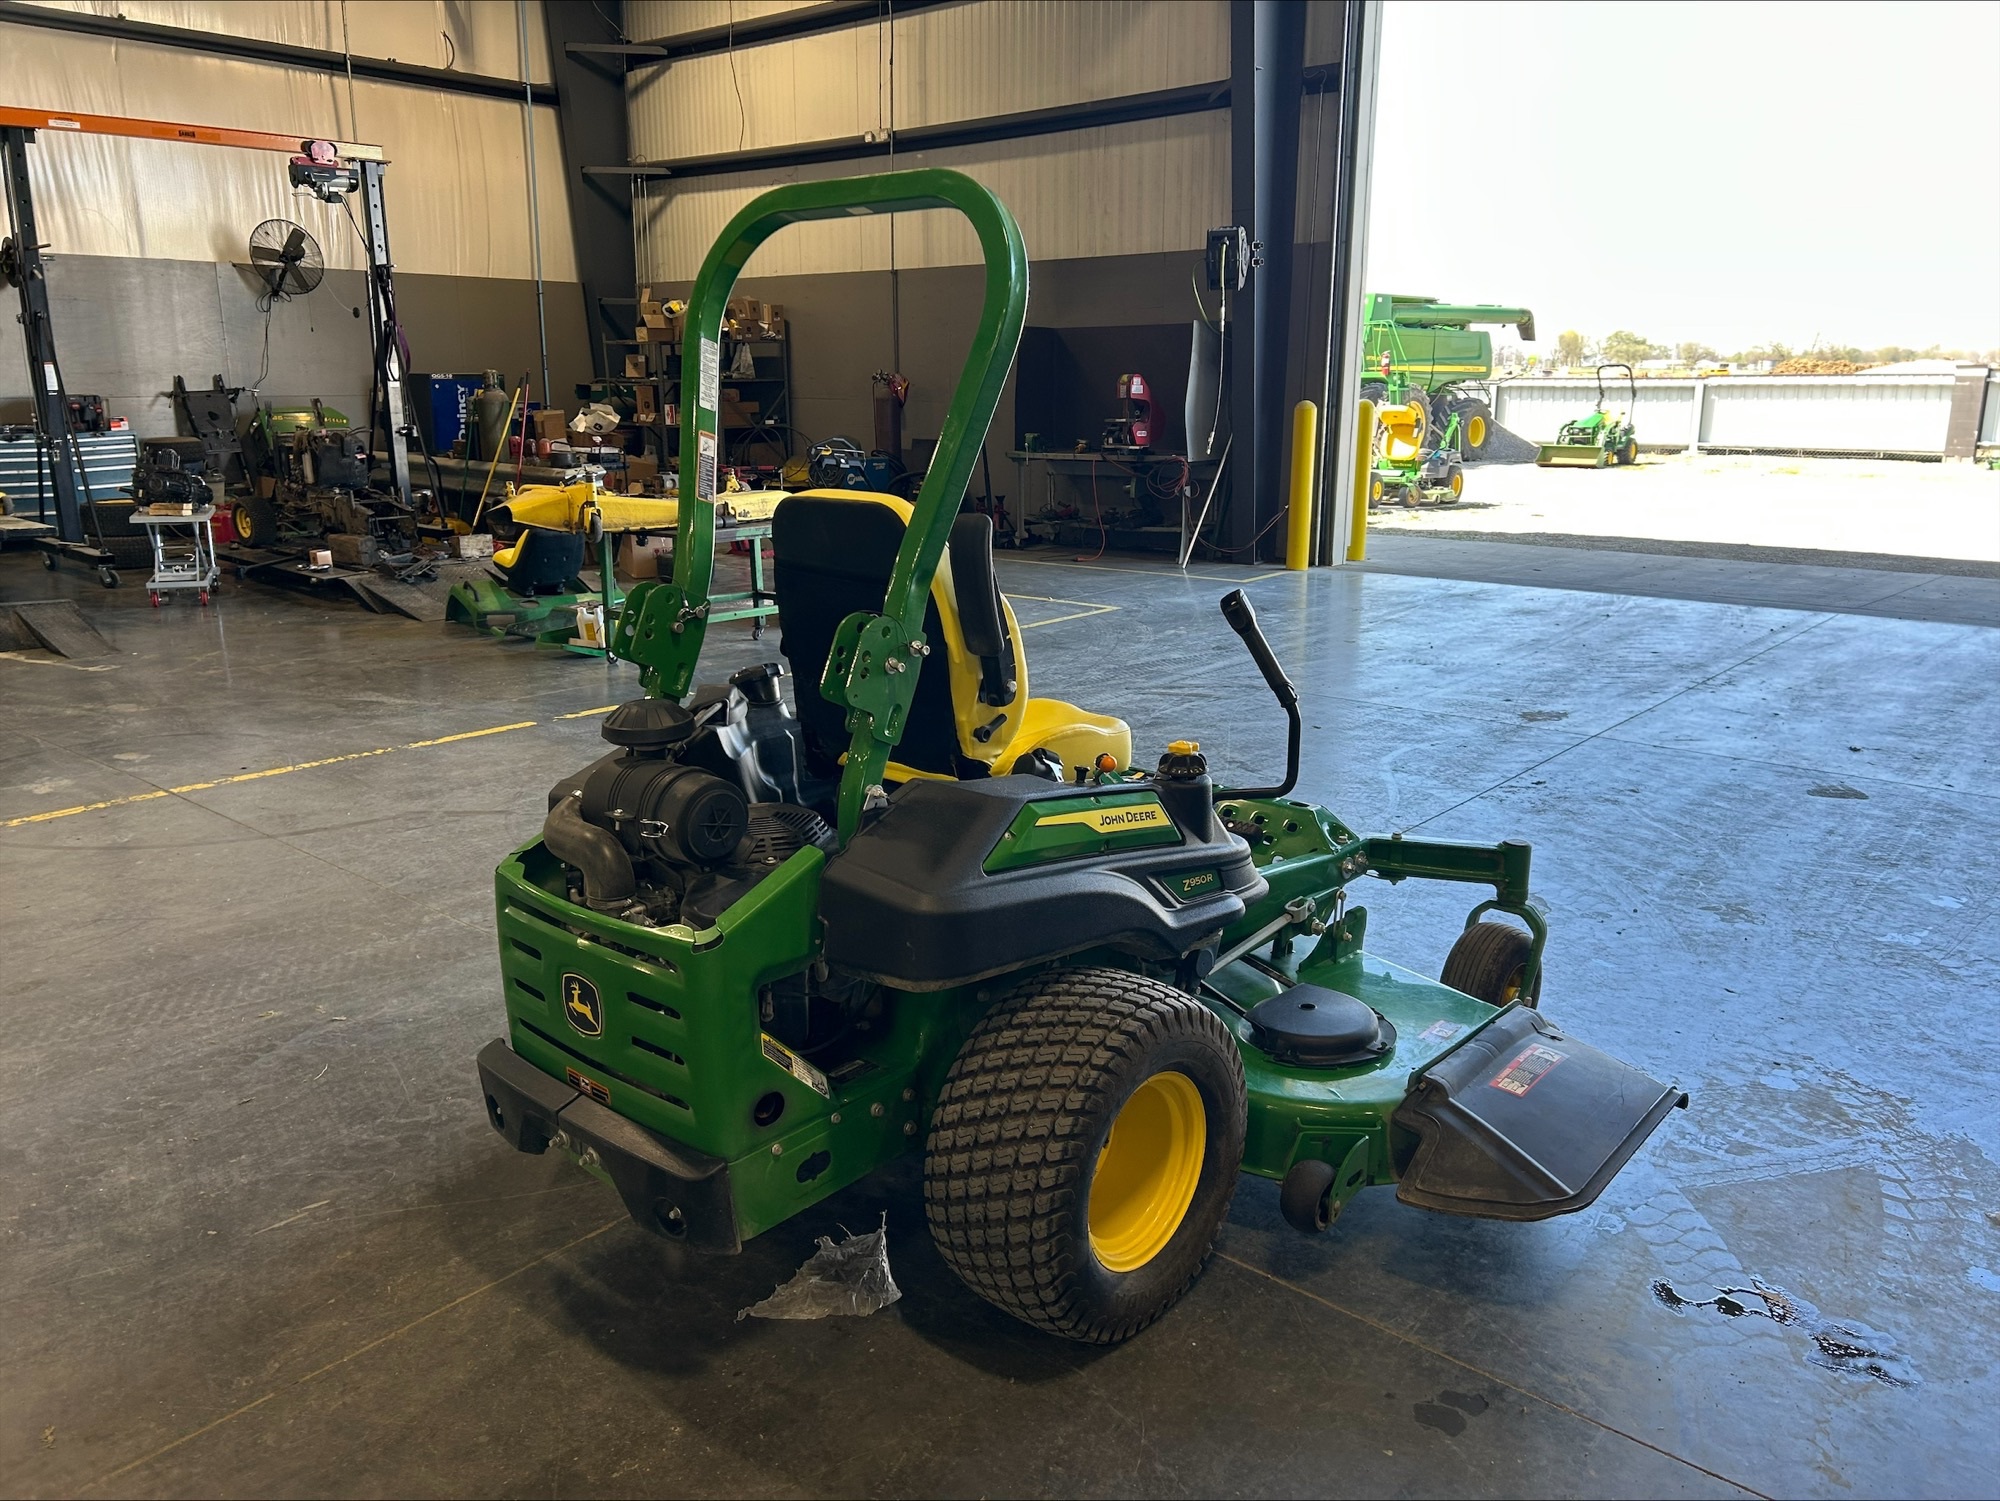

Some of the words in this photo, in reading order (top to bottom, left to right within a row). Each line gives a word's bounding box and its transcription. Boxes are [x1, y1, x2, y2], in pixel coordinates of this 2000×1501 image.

[1100, 814, 1125, 827] JOHN
[1126, 811, 1157, 823] DEERE
[1182, 873, 1213, 892] Z950R
